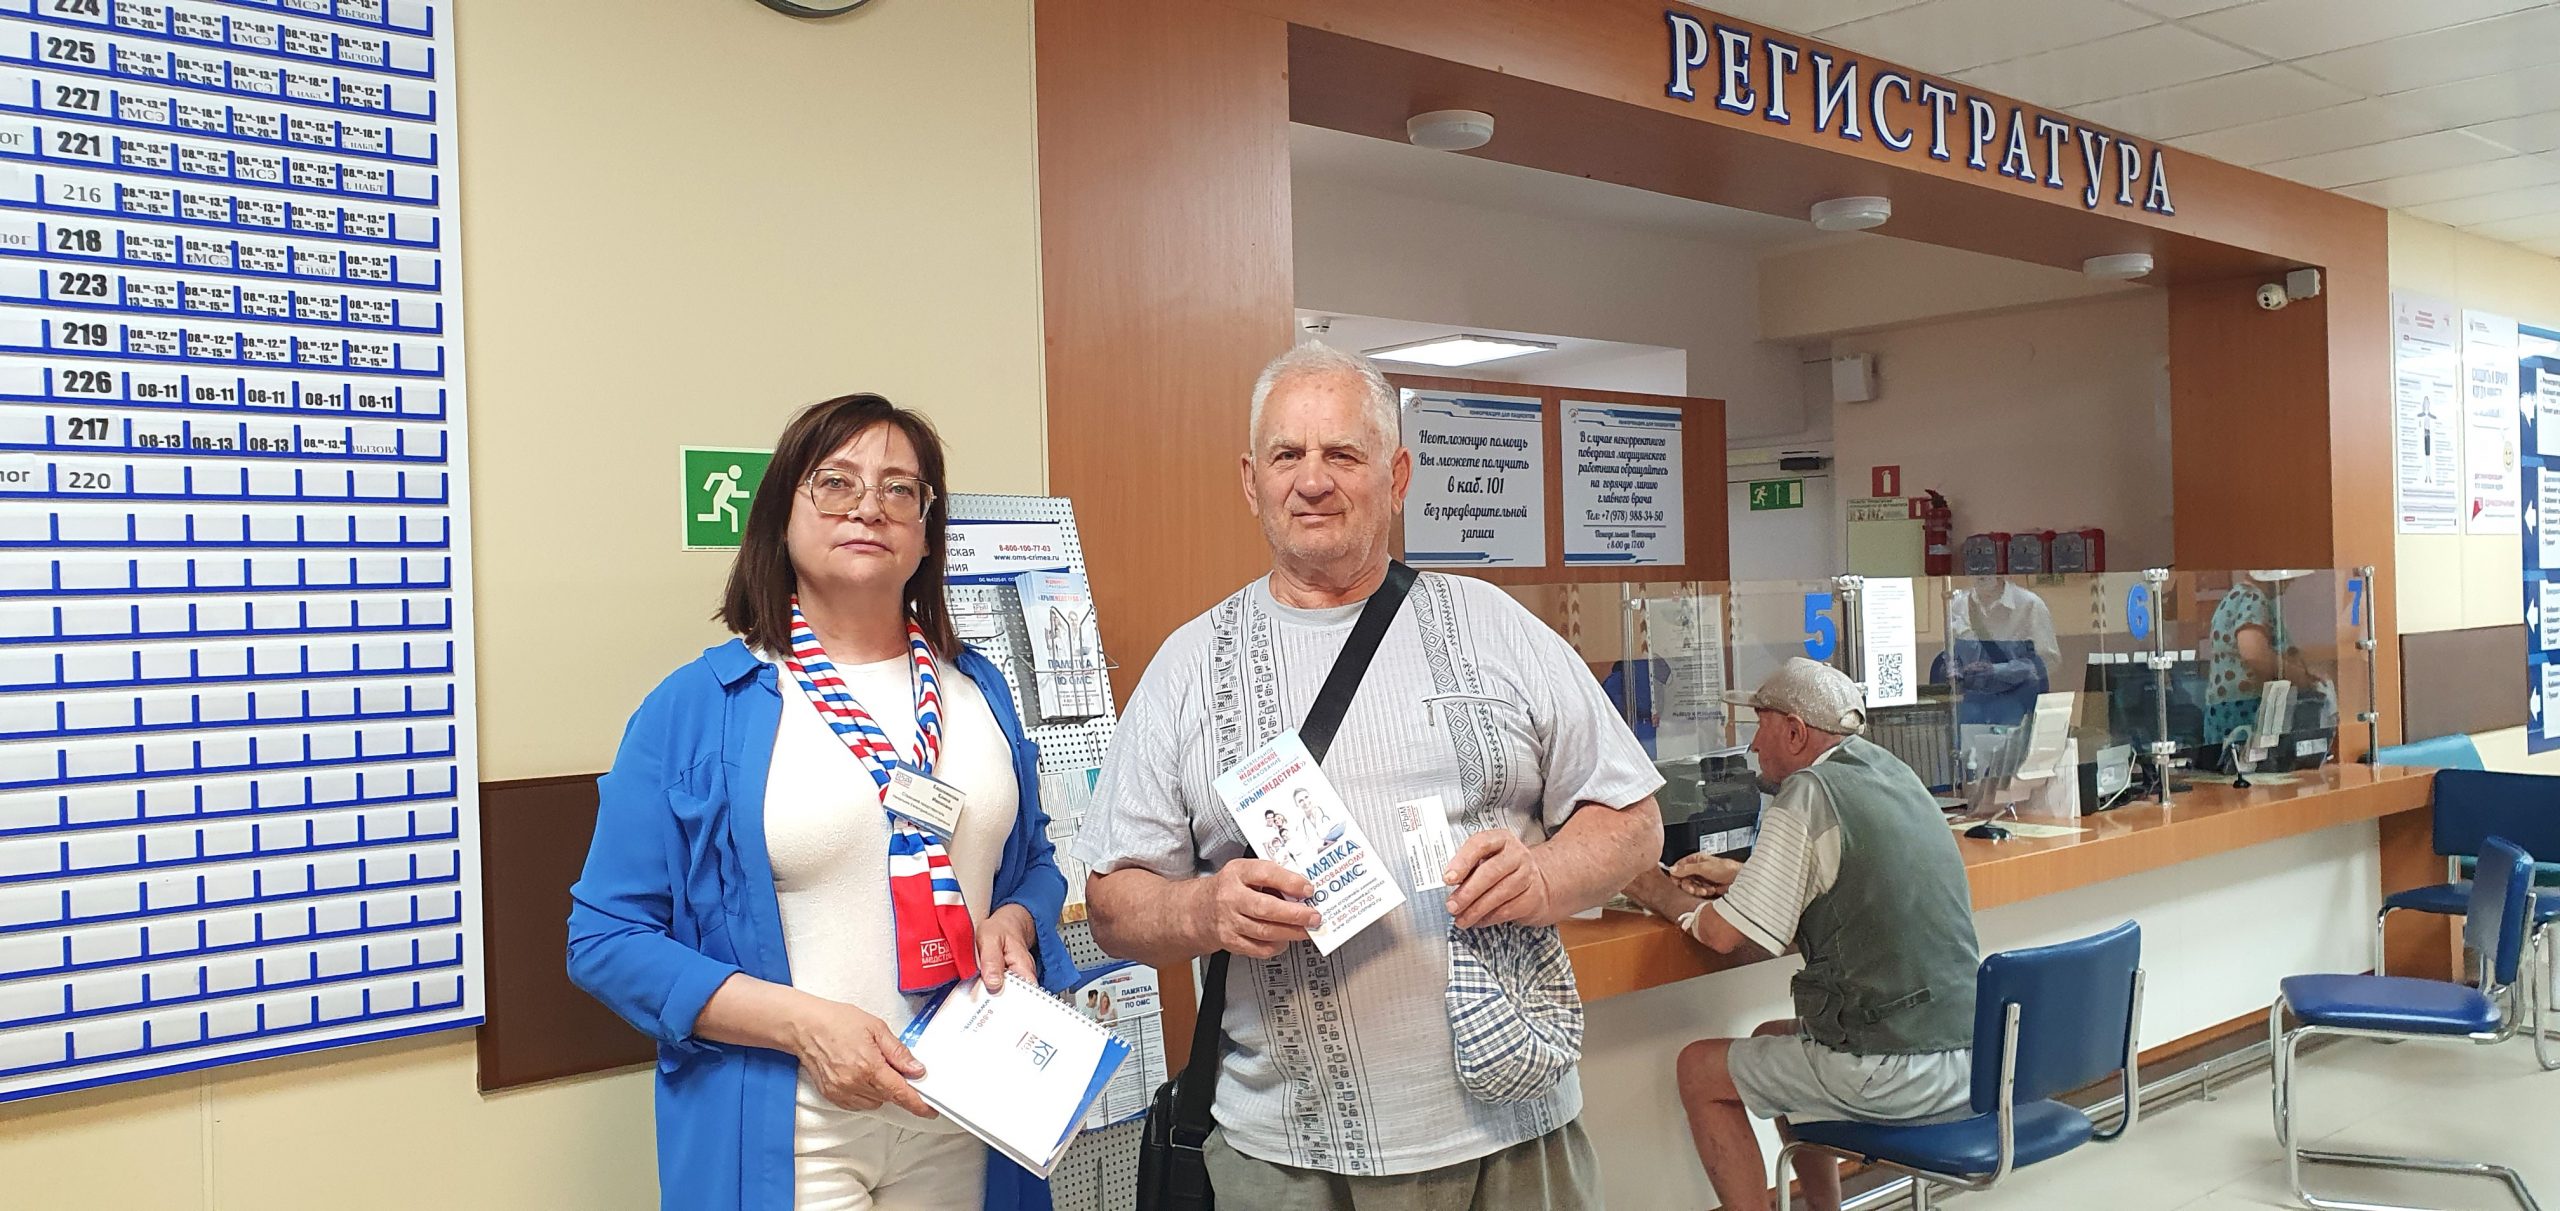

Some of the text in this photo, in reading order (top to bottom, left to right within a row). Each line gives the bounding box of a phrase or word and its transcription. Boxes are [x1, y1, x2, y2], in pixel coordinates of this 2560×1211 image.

[47, 37, 96, 63] 225
[56, 86, 100, 110] 227
[1666, 9, 2174, 216] РЕГИСТРАТУРА
[57, 131, 100, 156] 221
[63, 184, 102, 202] 216
[57, 228, 102, 252] 218
[60, 272, 108, 296] 223
[62, 322, 108, 346] 219
[62, 370, 112, 394] 226
[138, 384, 178, 398] 08-11
[196, 388, 234, 400] 08-11
[248, 390, 285, 404] 08-11
[306, 393, 340, 406] 08-11
[359, 395, 392, 408] 08-11
[68, 418, 109, 440] 217
[139, 434, 180, 448] 08-13
[193, 437, 232, 450] 08-13
[250, 438, 288, 451] 08-13
[1419, 430, 1528, 451] Неотложную помощь
[1580, 431, 1665, 448] В случае некорректного
[1419, 451, 1529, 473] Вы можете получить
[1578, 447, 1666, 462] поведения медицинского
[1578, 462, 1668, 477] работника обращайтесь
[68, 472, 111, 490] 220
[1448, 475, 1504, 494] в каб. 101
[1591, 480, 1658, 492] на горячую линию
[1598, 493, 1652, 506] главного врача
[1424, 503, 1527, 521] без предварительной
[1610, 510, 1628, 522] (978)
[1461, 529, 1494, 542] записи
[2127, 583, 2150, 639] 6
[2348, 579, 2362, 626] 7
[1804, 592, 1836, 660] 5
[1236, 761, 1306, 812] «КРЫММЕДСТРАХ»
[1306, 840, 1360, 880] МЯТКА
[1329, 864, 1367, 892] ОМС
[1122, 985, 1152, 996] ПАМЯТКА
